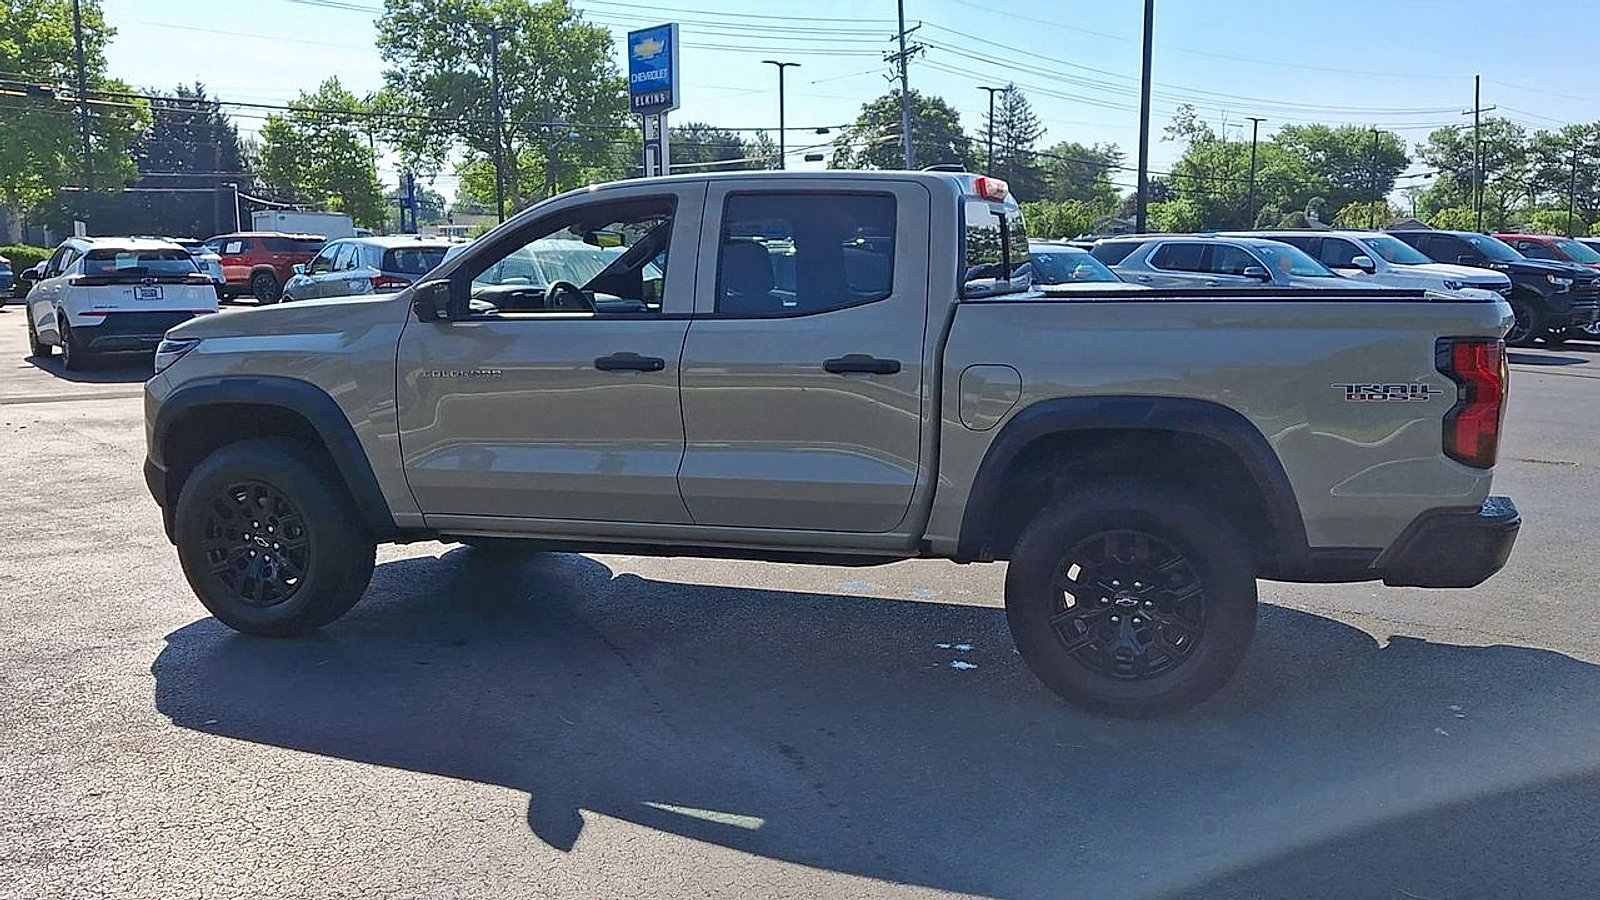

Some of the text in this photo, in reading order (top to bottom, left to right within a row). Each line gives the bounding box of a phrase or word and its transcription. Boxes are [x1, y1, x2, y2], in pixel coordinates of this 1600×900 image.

[635, 93, 666, 107] ELKINS
[1332, 383, 1442, 393] TRAIL
[1345, 392, 1430, 402] BOSS
